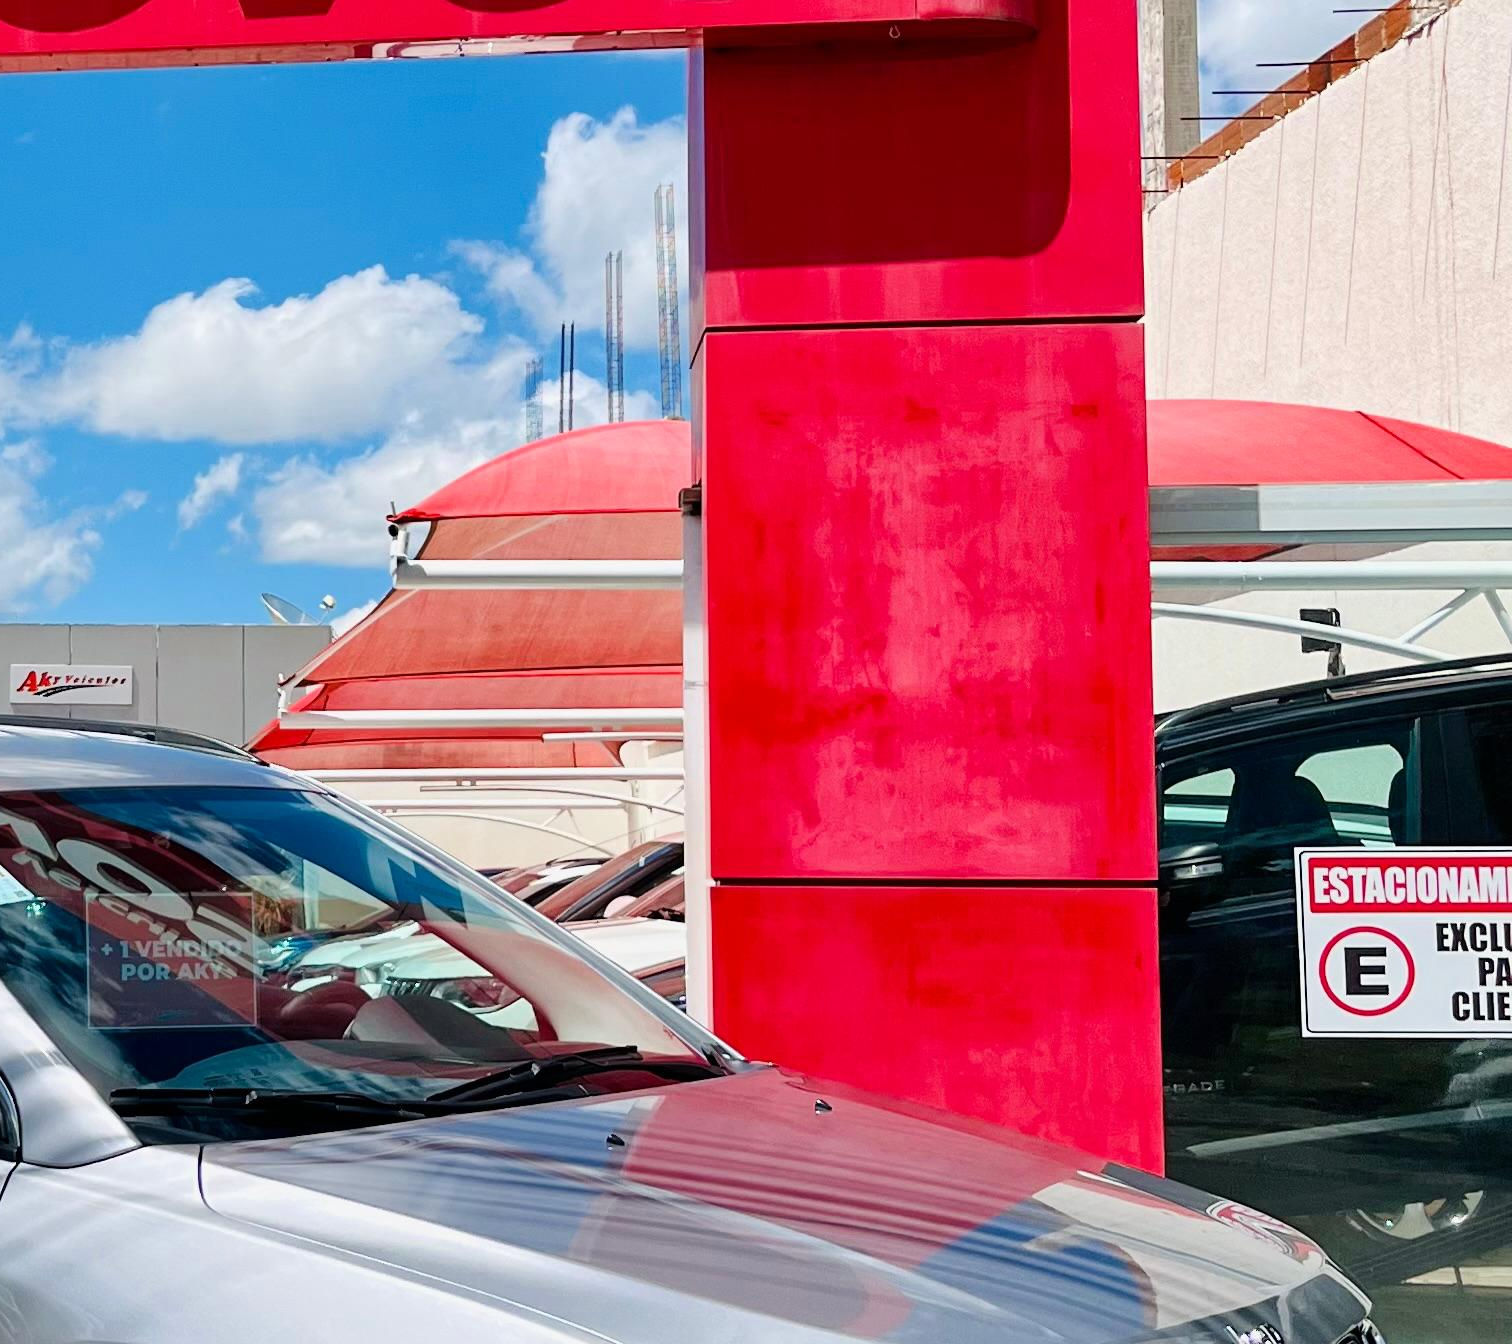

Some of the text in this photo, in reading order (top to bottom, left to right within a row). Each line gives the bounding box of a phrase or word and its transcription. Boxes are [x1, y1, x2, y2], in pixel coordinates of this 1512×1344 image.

[16, 670, 62, 692] Aky
[133, 940, 243, 958] VENDIDO
[121, 962, 222, 981] POR AKY
[1344, 946, 1390, 996] E
